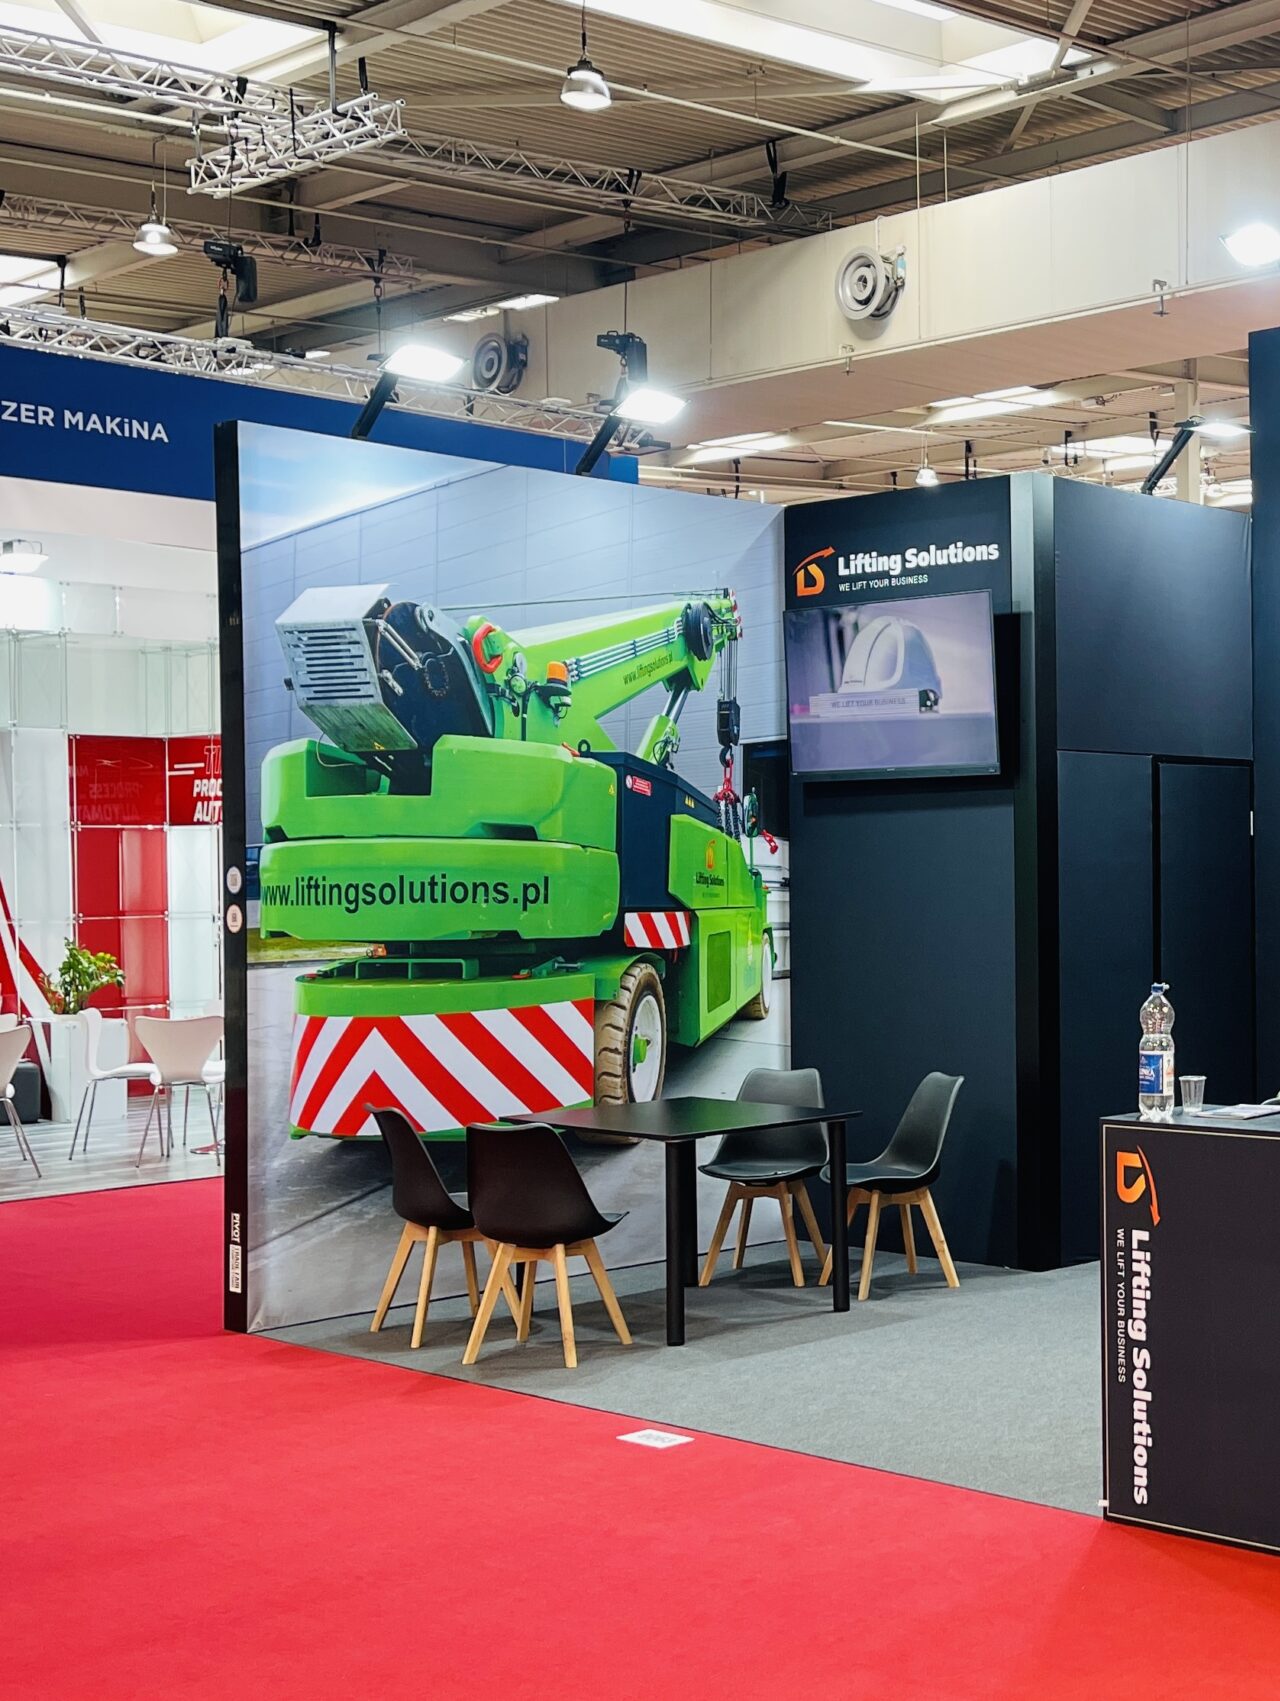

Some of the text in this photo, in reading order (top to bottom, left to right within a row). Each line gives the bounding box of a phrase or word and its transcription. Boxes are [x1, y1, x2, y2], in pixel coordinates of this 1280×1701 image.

[0, 400, 55, 427] ZER
[837, 541, 1000, 576] Lifting Solutions
[839, 574, 929, 592] WE LIFT YOUR BUSINESS
[193, 801, 223, 823] AUT
[261, 873, 550, 913] www.liftingsolutions.pl
[1116, 1227, 1127, 1384] WE LIFT YOUR BUSINESS
[1127, 1229, 1153, 1505] Lifting Solutions
